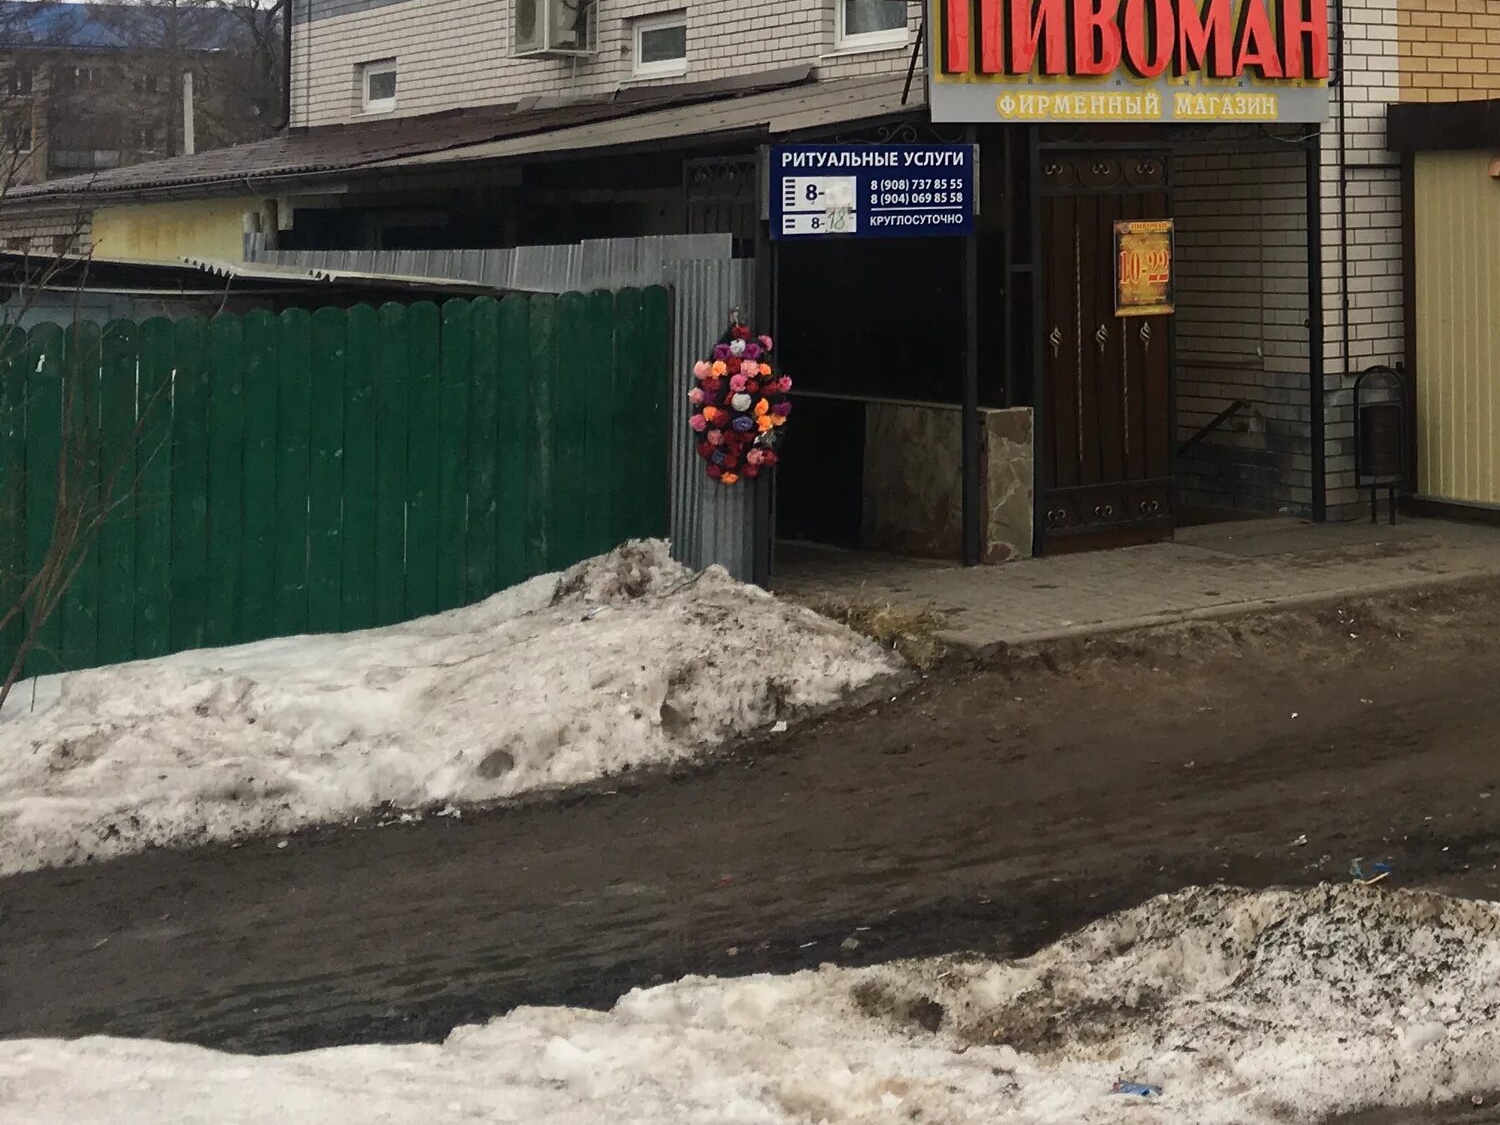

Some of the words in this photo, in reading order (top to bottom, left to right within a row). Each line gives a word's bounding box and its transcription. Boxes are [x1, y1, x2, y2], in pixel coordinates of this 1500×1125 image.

[999, 91, 1160, 117] ФИРМЕННЫЙ
[1175, 94, 1277, 117] МАГАЗИН
[782, 152, 898, 167] РИТУАЛЬНЫЕ
[904, 152, 964, 166] УСЛУГИ
[870, 180, 877, 191] 8
[880, 179, 909, 192] (908)
[912, 179, 932, 190] 737
[934, 179, 947, 190] 85
[950, 179, 963, 189] 55
[870, 194, 877, 205] 8
[880, 193, 909, 205] (904)
[912, 193, 932, 204] 069
[934, 193, 947, 203] 85
[950, 192, 963, 202] 58
[870, 213, 963, 226] КРУГЛОСУТОЧНО
